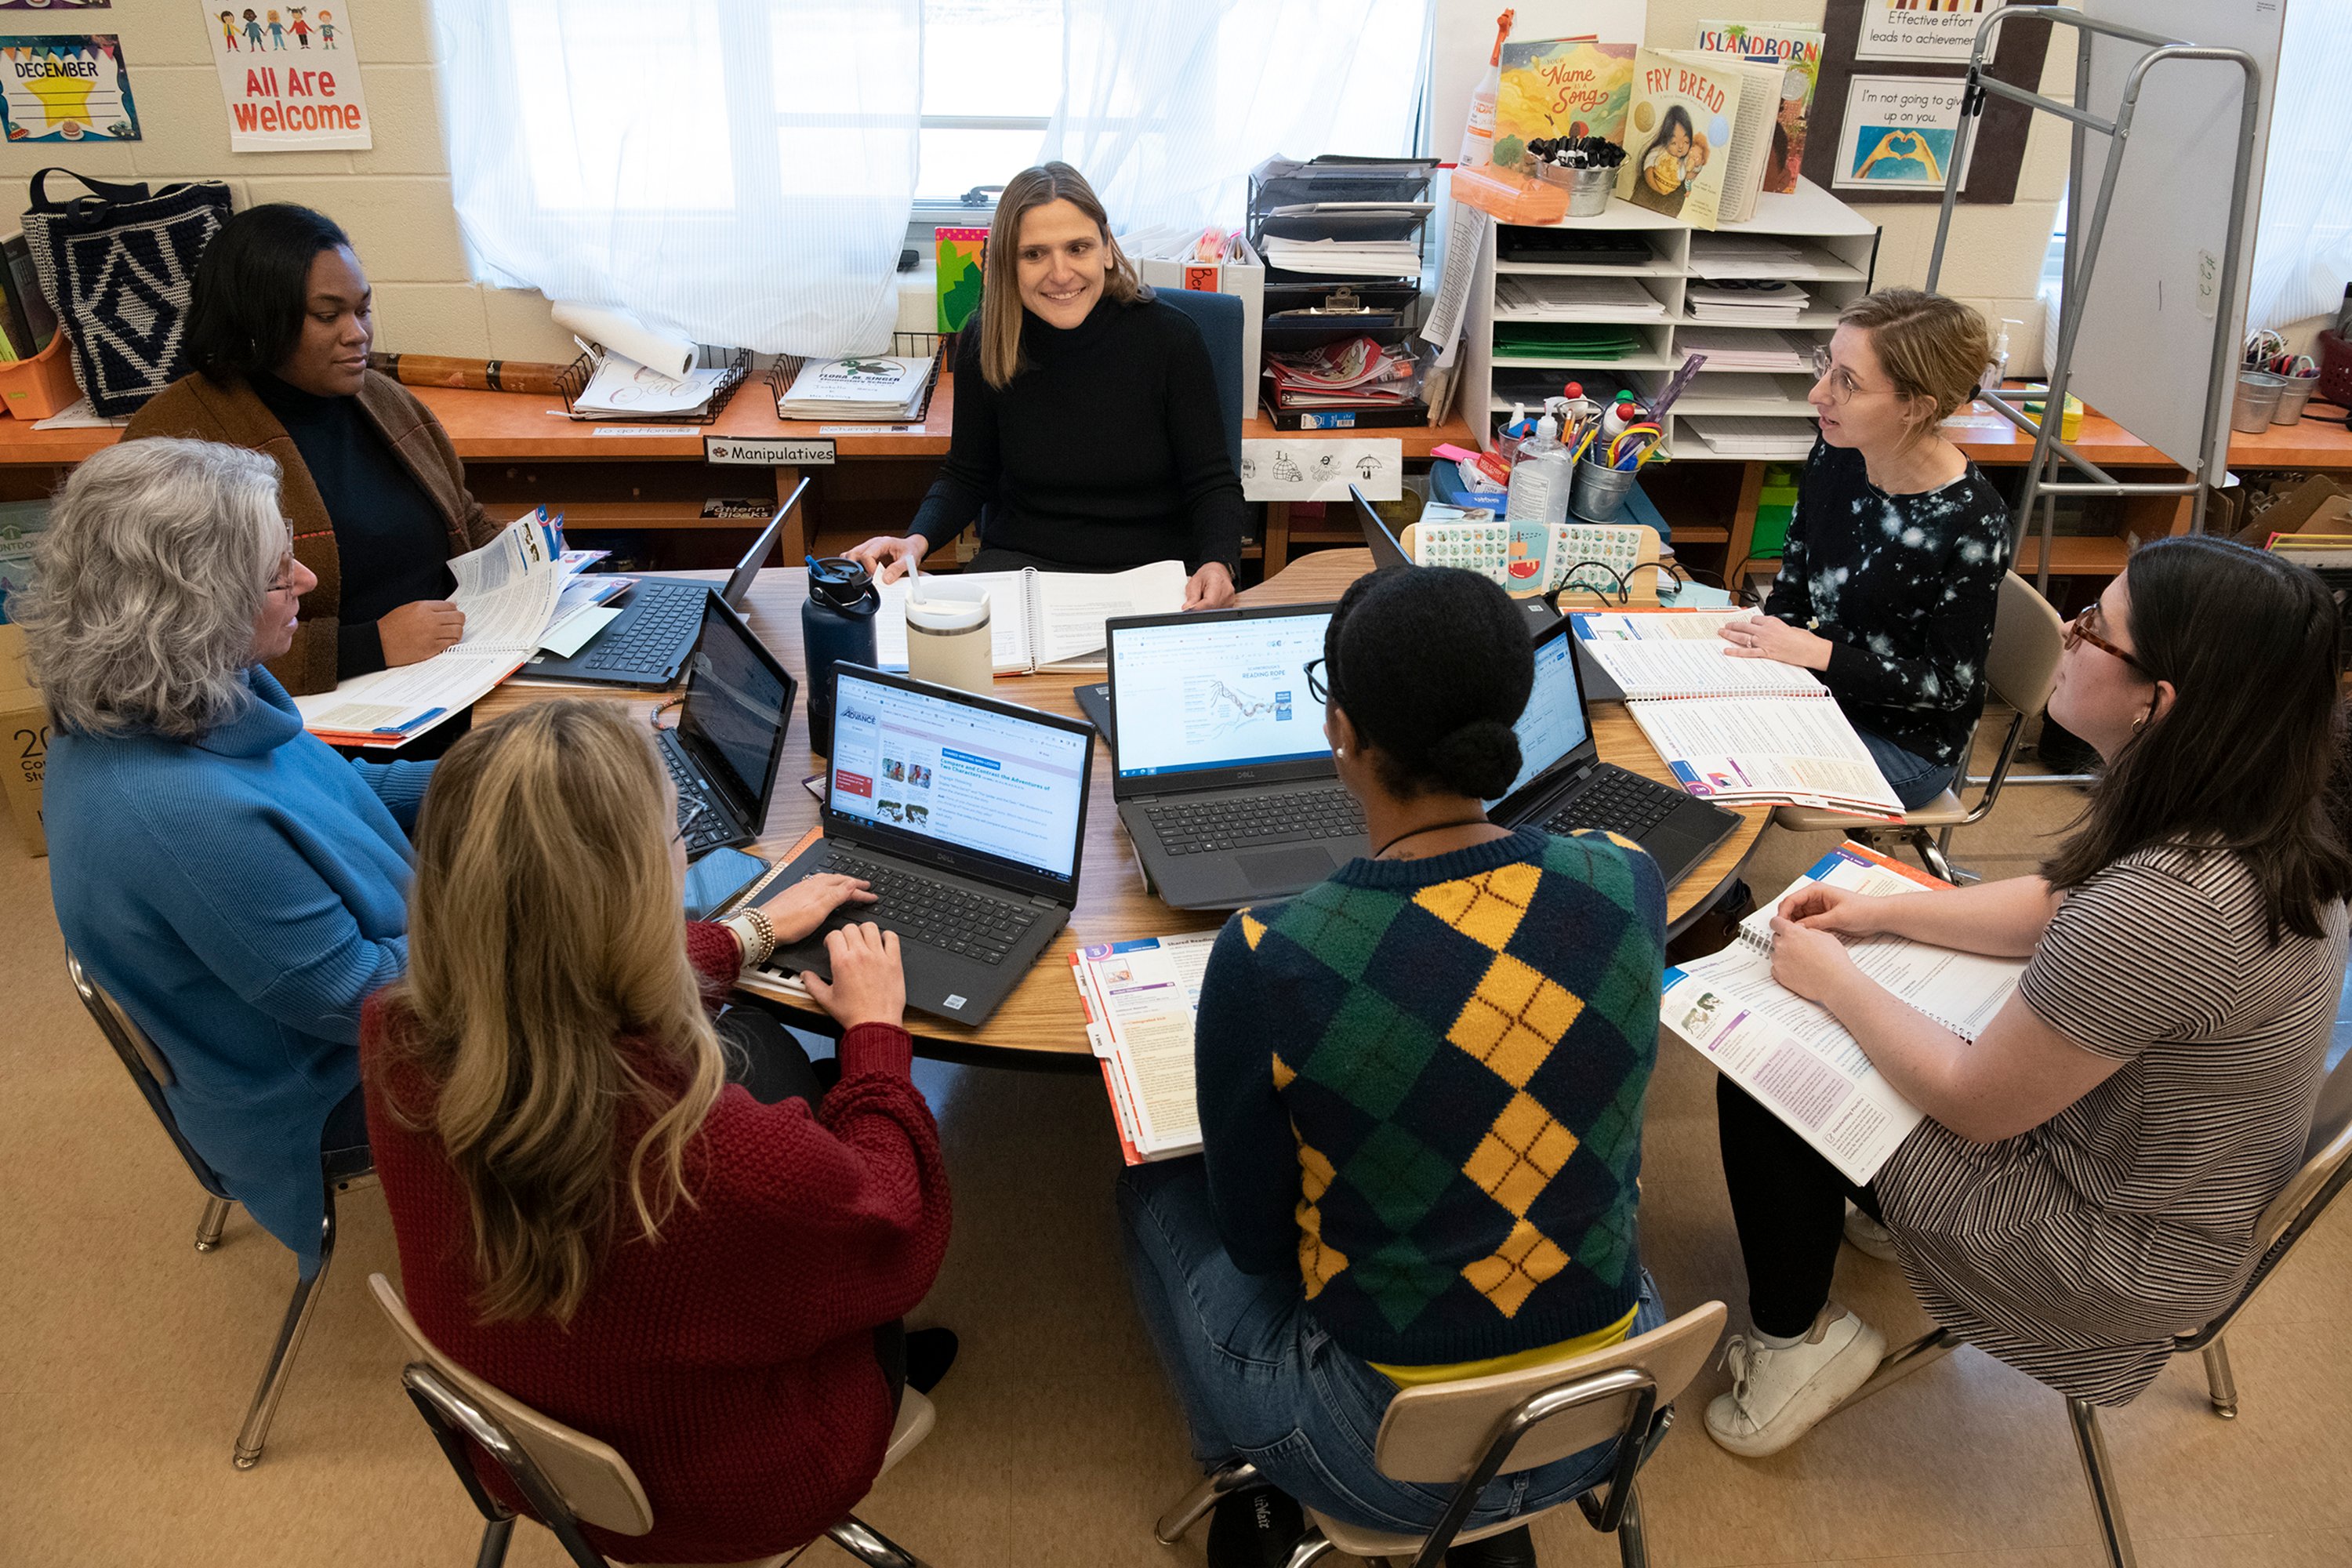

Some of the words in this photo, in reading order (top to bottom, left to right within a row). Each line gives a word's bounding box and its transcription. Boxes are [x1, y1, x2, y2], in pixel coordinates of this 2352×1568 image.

[1888, 10, 1939, 26] Effective
[1941, 13, 1974, 27] effort
[1700, 31, 1818, 62] ISLANDBORN
[1869, 28, 1898, 43] leads
[1902, 32, 1913, 44] to
[1915, 31, 1976, 45] achievemen
[15, 62, 99, 78] DECEMBER
[1541, 64, 1595, 87] Name
[246, 67, 278, 98] All
[289, 67, 336, 97] Are
[1646, 67, 1671, 95] FRY
[1679, 70, 1725, 114] BREAD
[1552, 86, 1609, 114] Song
[1862, 89, 1877, 103] I'm
[1880, 93, 1898, 103] not
[1900, 93, 1929, 108] going
[1933, 96, 1944, 105] to
[1946, 96, 1963, 111] giv
[233, 100, 361, 132] Welcome
[1884, 113, 1897, 124] up
[1916, 114, 1936, 123] you.
[731, 445, 833, 463] Manipulatives
[842, 710, 877, 725] ADVANCE
[940, 758, 964, 769] Compare
[976, 768, 1000, 779] Contrast
[1011, 777, 1043, 790] Adventures
[952, 767, 982, 779] Characters
[937, 853, 955, 864] DELL
[1831, 1110, 1855, 1134] Handwriting
[1850, 1097, 1866, 1113] Practice
